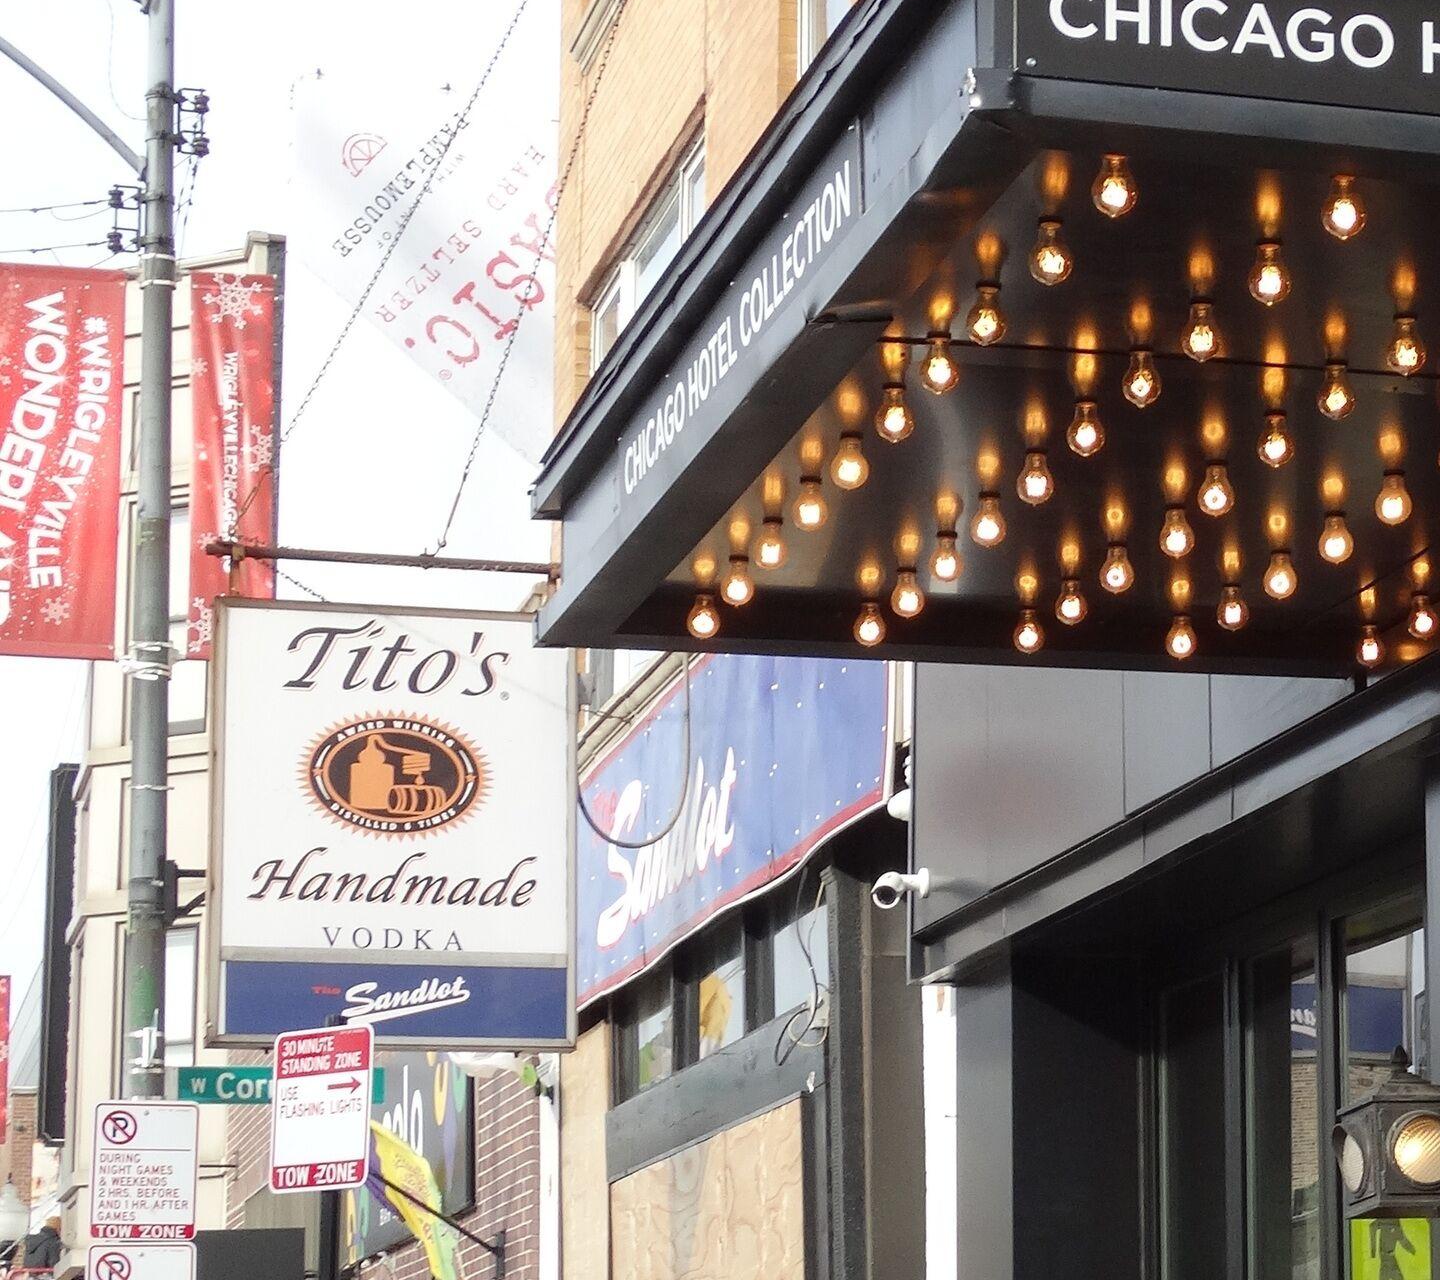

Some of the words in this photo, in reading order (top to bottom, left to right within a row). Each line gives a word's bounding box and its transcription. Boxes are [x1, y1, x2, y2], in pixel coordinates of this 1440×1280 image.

[331, 112, 471, 258] PAMPLEMOUSSE
[375, 220, 483, 324] SELTZER
[623, 380, 686, 494] CHICAGO
[687, 320, 738, 418] HOTEL
[738, 160, 853, 347] COLLECTION
[27, 315, 112, 589] #WRIGLEYVILLE
[282, 619, 511, 698] Tito's
[336, 721, 386, 742] AWARD
[393, 721, 456, 748] WINNING
[330, 803, 398, 831] DISTILLED
[418, 808, 456, 830] TIMES
[247, 847, 538, 908] Handmade
[322, 926, 465, 952] VODKA
[341, 975, 470, 1019] Sandlot
[281, 1040, 297, 1057] 30
[297, 1035, 335, 1055] MINUTE
[281, 1054, 331, 1075] STANDING
[333, 1050, 362, 1070] ZONE
[281, 1086, 299, 1101] USE
[281, 1101, 325, 1119] FLASHING
[329, 1097, 362, 1116] LIGHTS
[99, 1153, 141, 1163] DURING
[99, 1165, 132, 1175] NIGHT
[136, 1165, 173, 1175] GAMES
[99, 1177, 107, 1187] &
[112, 1177, 168, 1187] WEEKENDS
[276, 1166, 308, 1187] TOW
[314, 1161, 359, 1184] ZONE
[98, 1188, 106, 1198] 2
[137, 1188, 180, 1198] BEFORE
[98, 1200, 120, 1209] AND
[152, 1200, 189, 1210] AFTER
[97, 1211, 136, 1221] GAMES
[95, 1225, 133, 1238] TOW
[138, 1225, 186, 1238] ZONE
